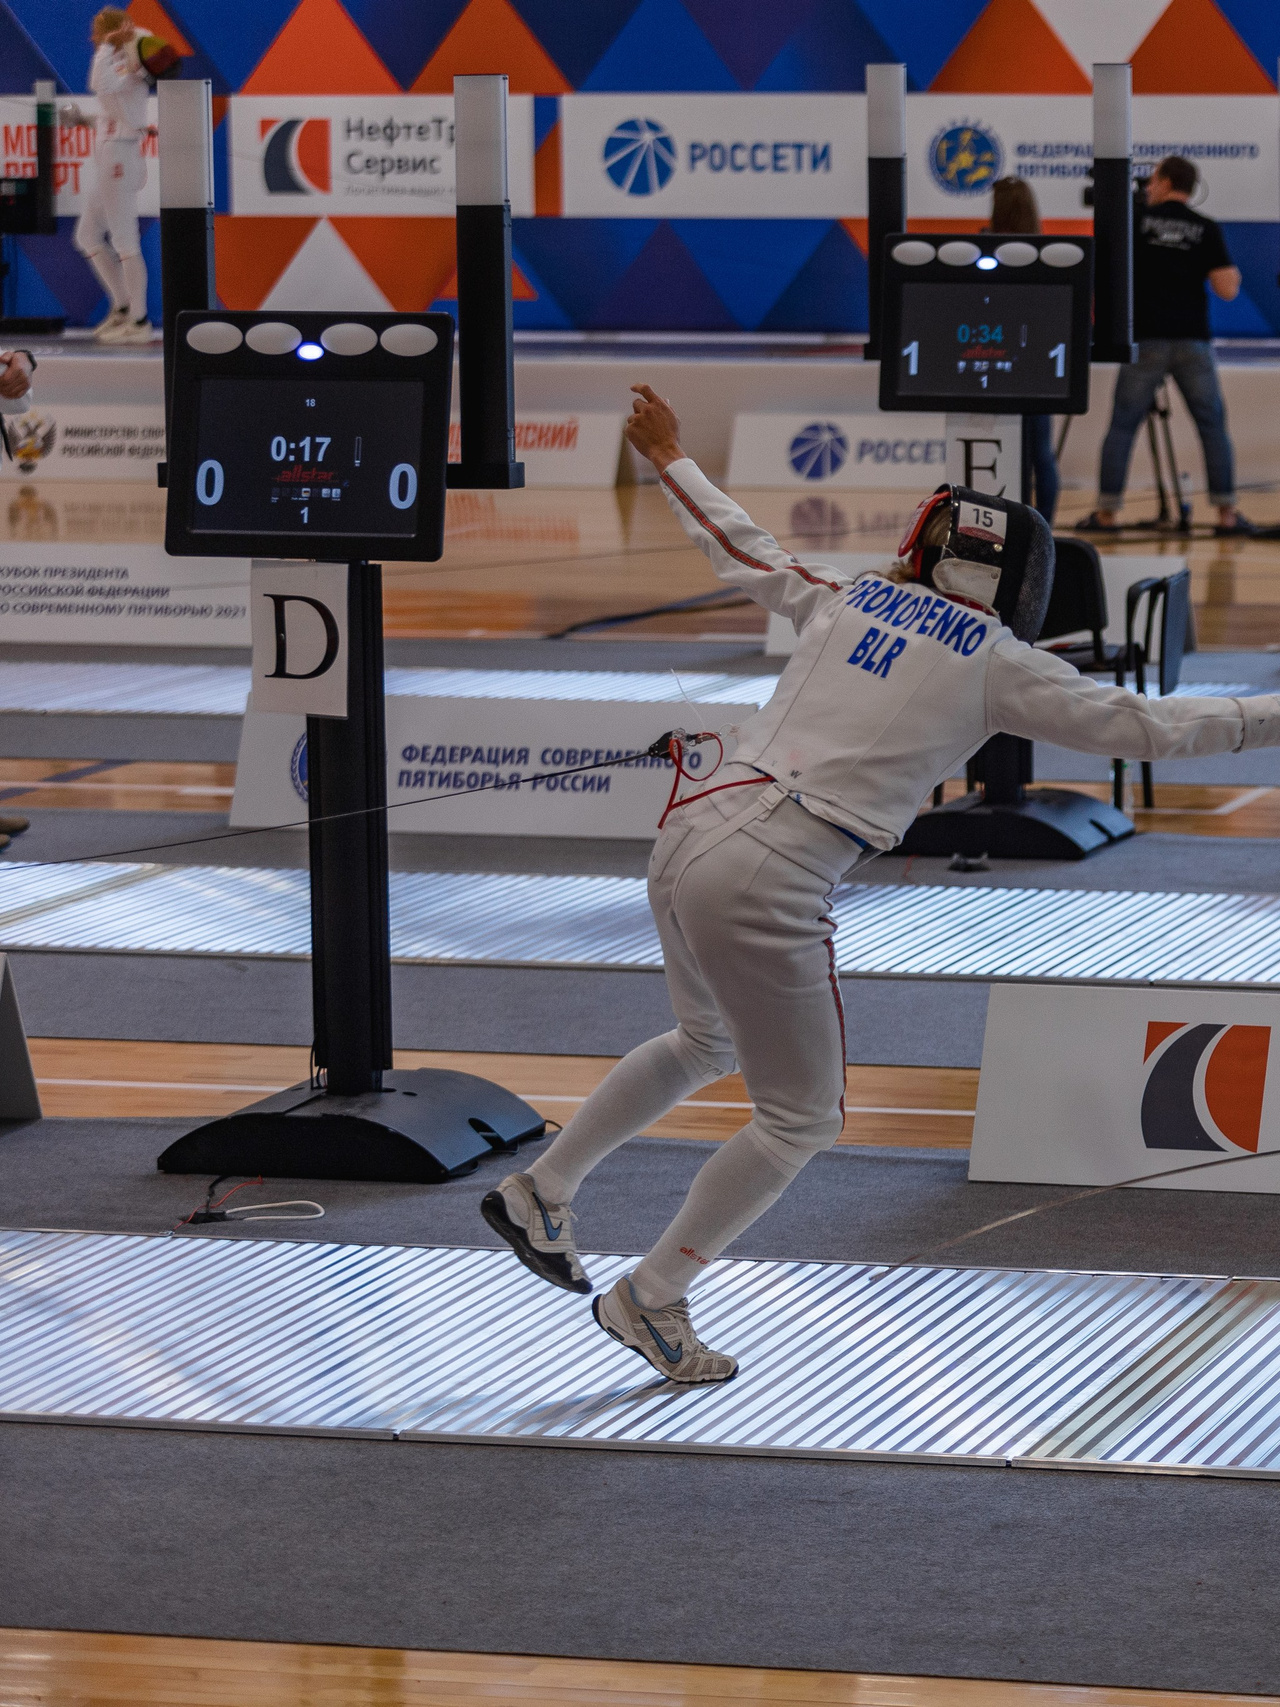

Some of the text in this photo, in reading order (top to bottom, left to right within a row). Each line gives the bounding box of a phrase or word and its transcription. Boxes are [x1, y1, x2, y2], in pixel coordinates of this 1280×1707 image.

[346, 152, 441, 179] Сервис
[690, 142, 831, 173] РОССЕТИ
[957, 324, 1003, 343] 0:34
[902, 341, 919, 376] 1
[1049, 343, 1066, 378] 1
[305, 398, 316, 407] 18
[271, 436, 331, 461] 0:17
[857, 439, 946, 464] РОССЕТ
[956, 438, 1003, 498] E
[196, 459, 224, 505] 0
[389, 463, 417, 509] 0
[300, 507, 309, 523] 1
[972, 507, 994, 528] 15
[44, 567, 129, 580] ПРЕЗИДЕНТА
[0, 584, 170, 598] ОССИЙСКОЙ ФЕДЕРАЦИИ
[846, 579, 988, 657] PROKOPENKO
[264, 594, 340, 680] D
[847, 627, 908, 678] BLR
[401, 744, 530, 768] ФЕДЕРАЦИЯ
[399, 769, 612, 793] ПЯТИБОРЬЯ РОССИИ
